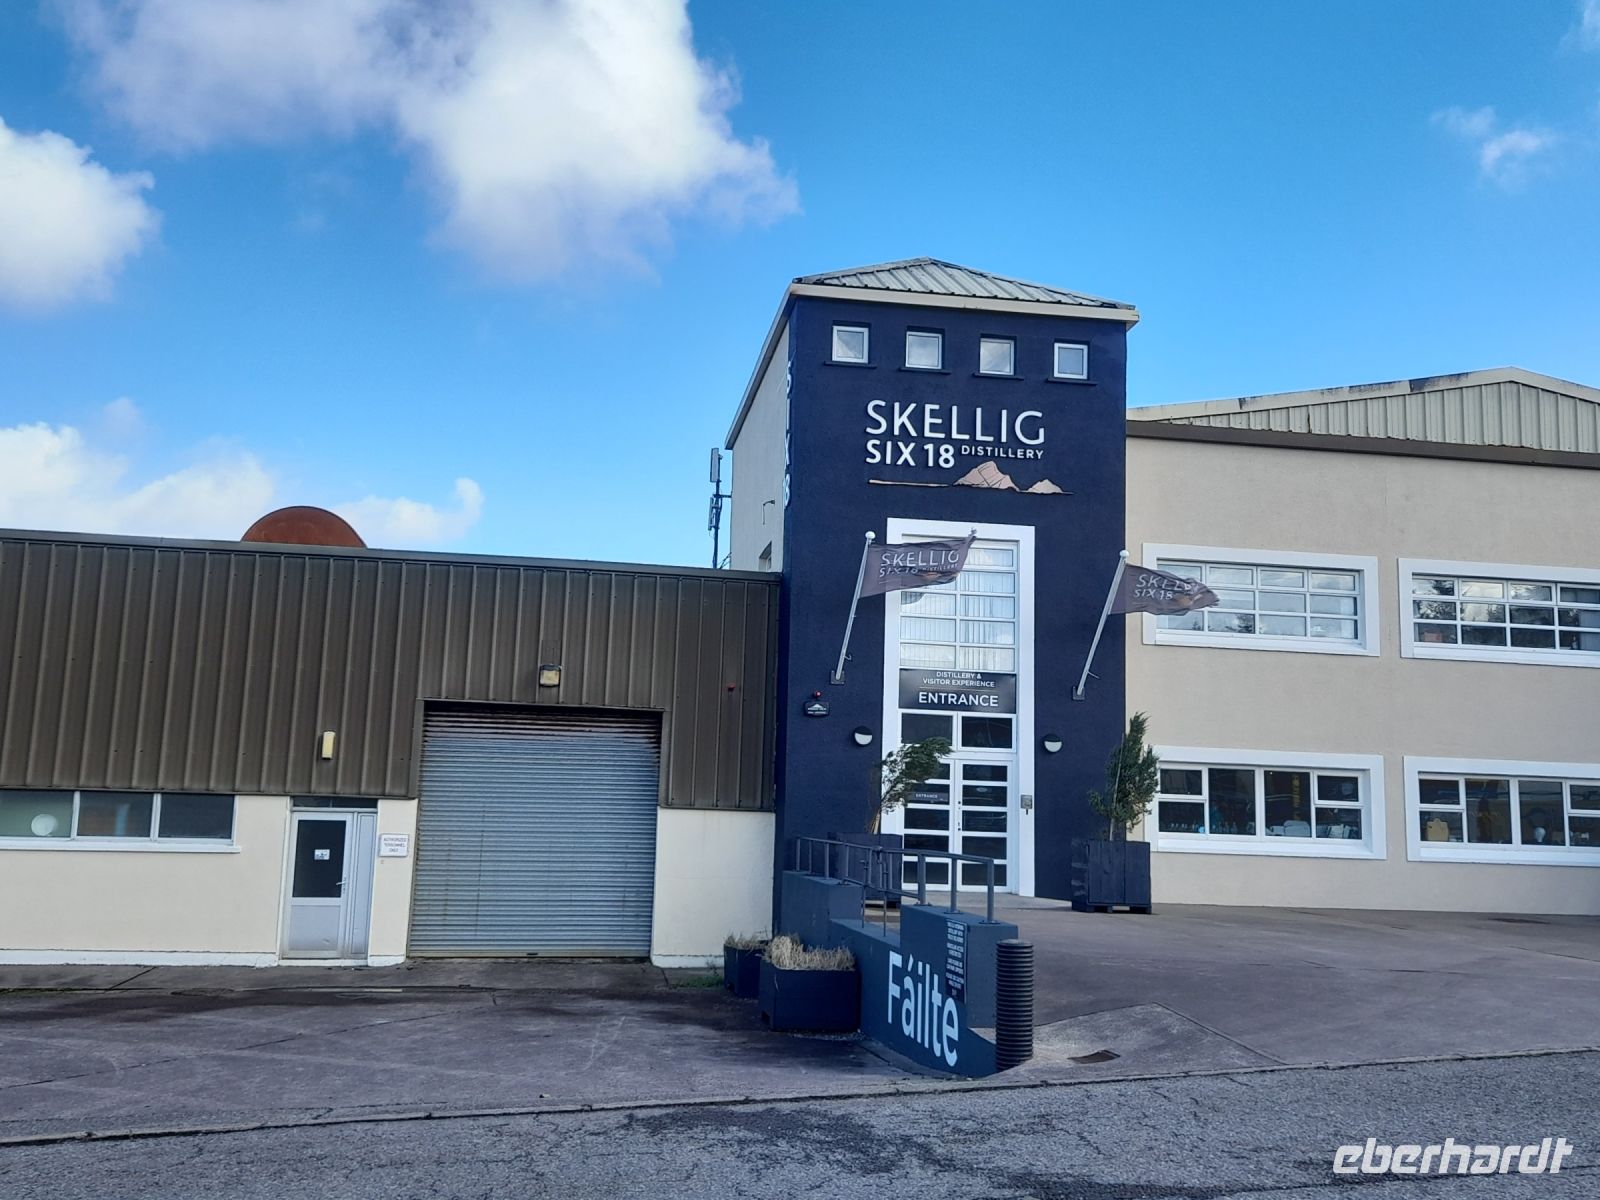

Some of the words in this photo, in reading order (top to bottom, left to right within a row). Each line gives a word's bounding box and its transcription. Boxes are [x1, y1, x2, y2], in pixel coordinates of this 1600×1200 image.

[865, 399, 1045, 445] SKELLIG
[961, 444, 1044, 460] DISTILLERY
[936, 671, 975, 679] DISTILLERY
[952, 680, 995, 688] EXPERIENCE
[918, 691, 999, 707] ENTRANCE
[887, 950, 959, 1067] Fáilte
